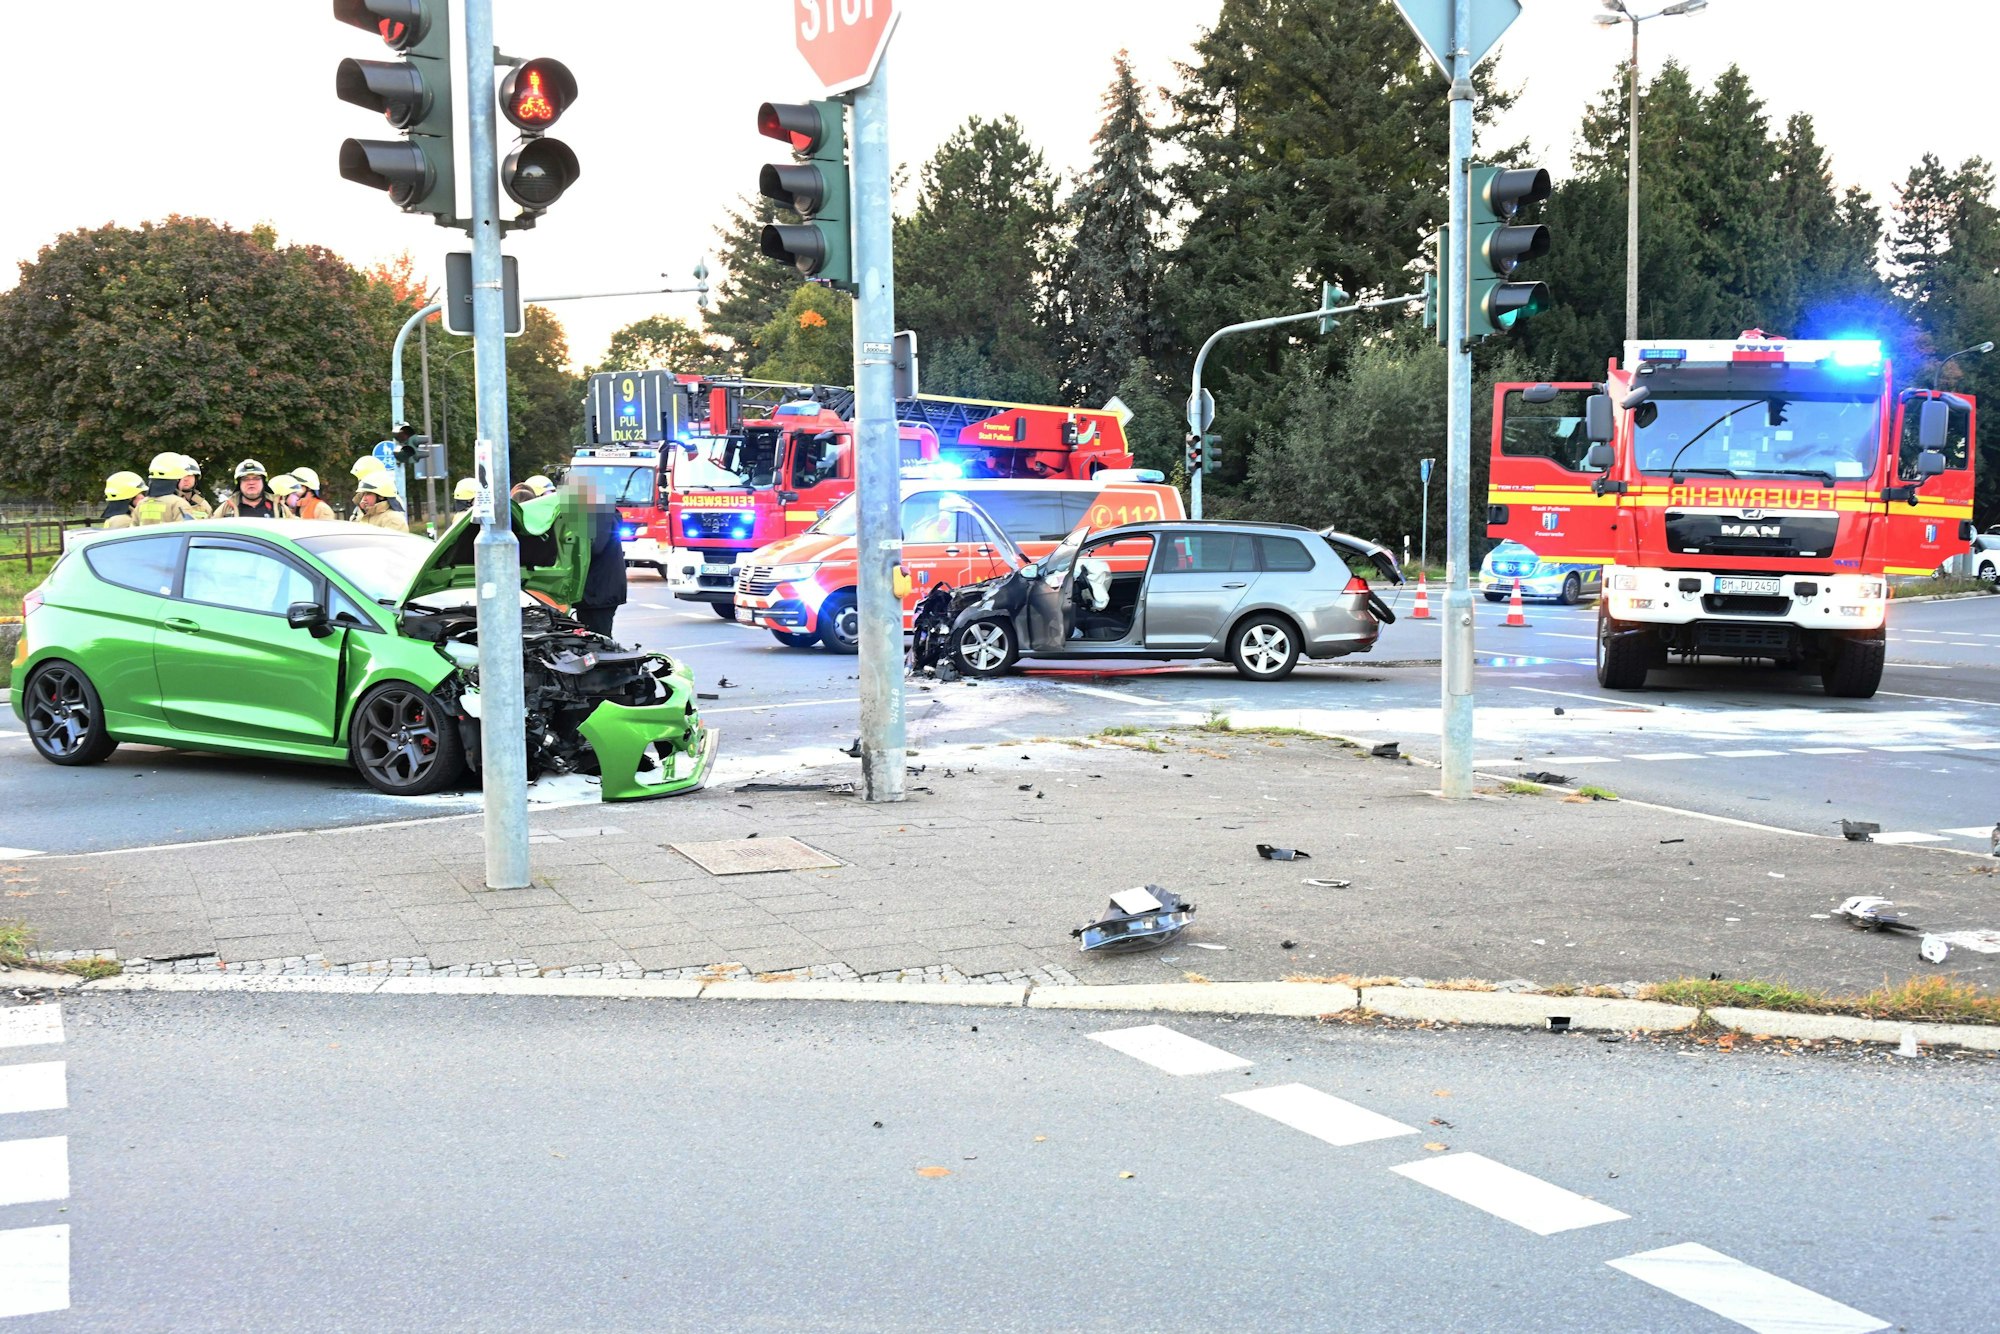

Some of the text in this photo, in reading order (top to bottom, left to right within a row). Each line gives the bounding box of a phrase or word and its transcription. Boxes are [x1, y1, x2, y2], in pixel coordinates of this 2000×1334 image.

[622, 379, 635, 402] 9
[620, 416, 639, 428] PUL
[983, 422, 1011, 431] Feuerwehr
[614, 430, 645, 441] DLK 23
[1117, 506, 1158, 524] 112
[1721, 524, 1780, 537] MAN
[1721, 579, 1778, 591] BM PU 2450
